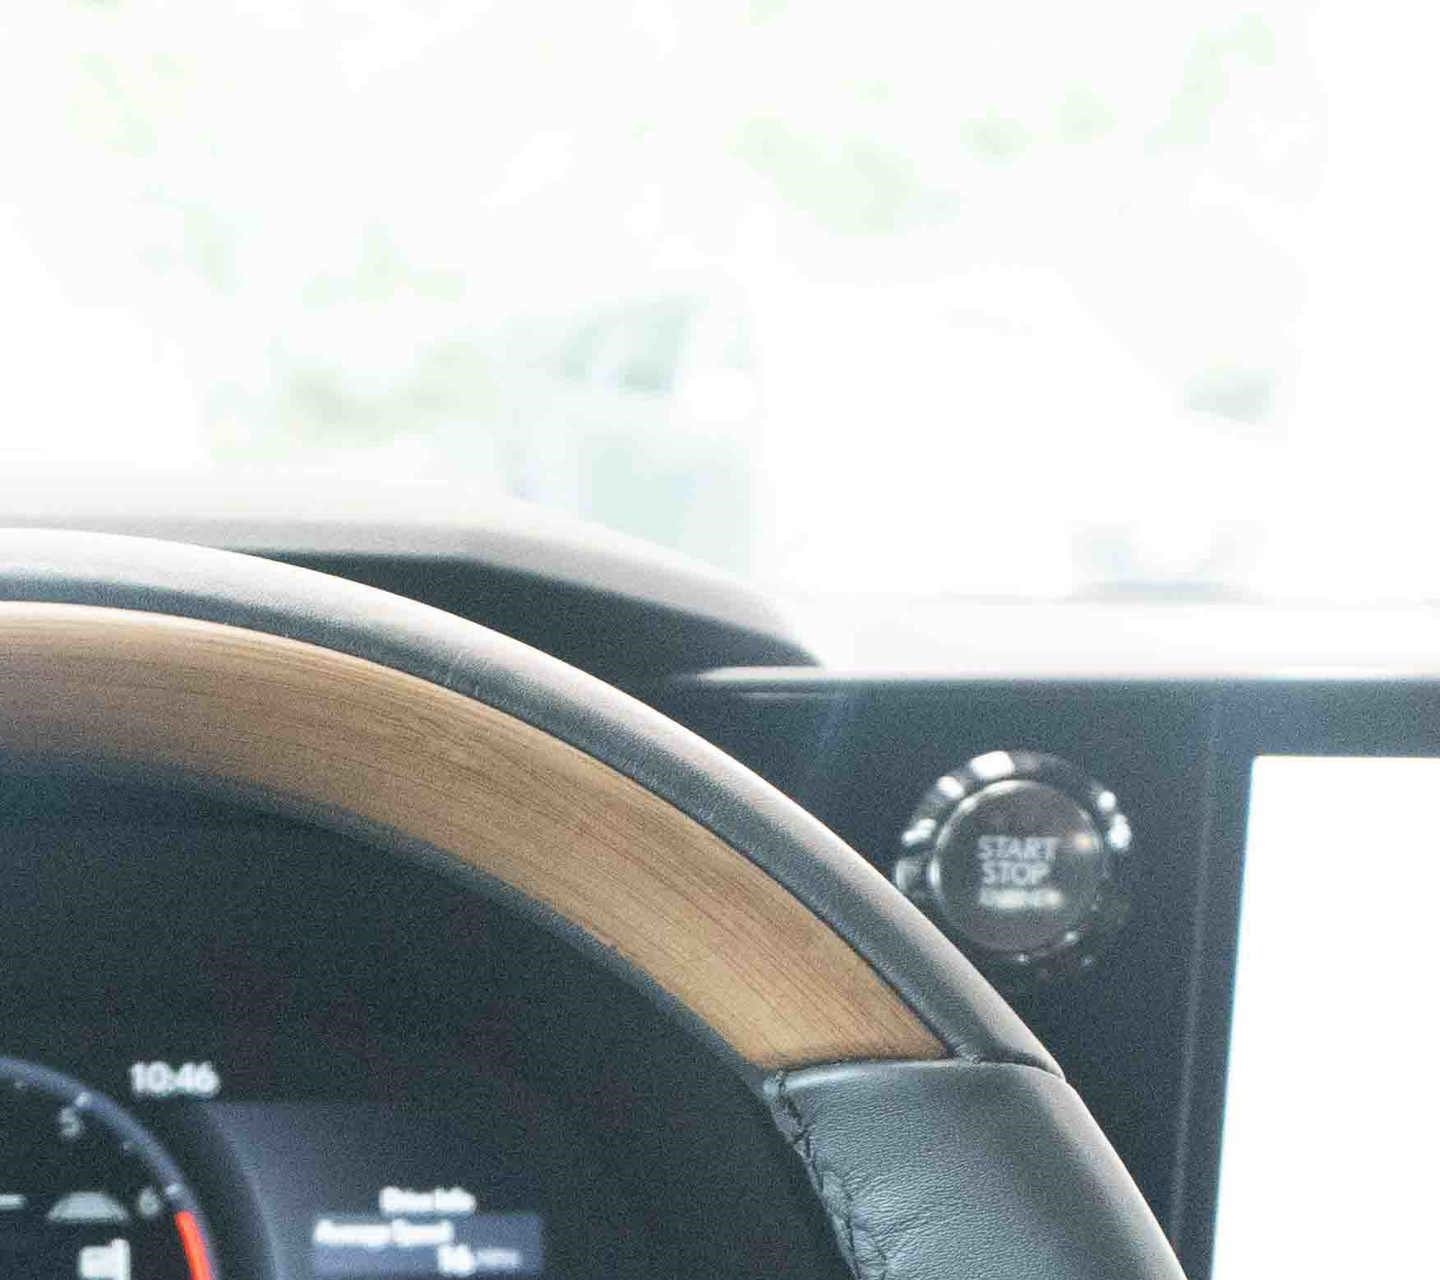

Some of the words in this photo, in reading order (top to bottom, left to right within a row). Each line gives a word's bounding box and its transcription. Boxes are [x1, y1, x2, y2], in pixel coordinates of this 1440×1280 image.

[978, 835, 1059, 859] START
[981, 860, 1051, 886] STOP
[131, 1061, 220, 1099] 10:46
